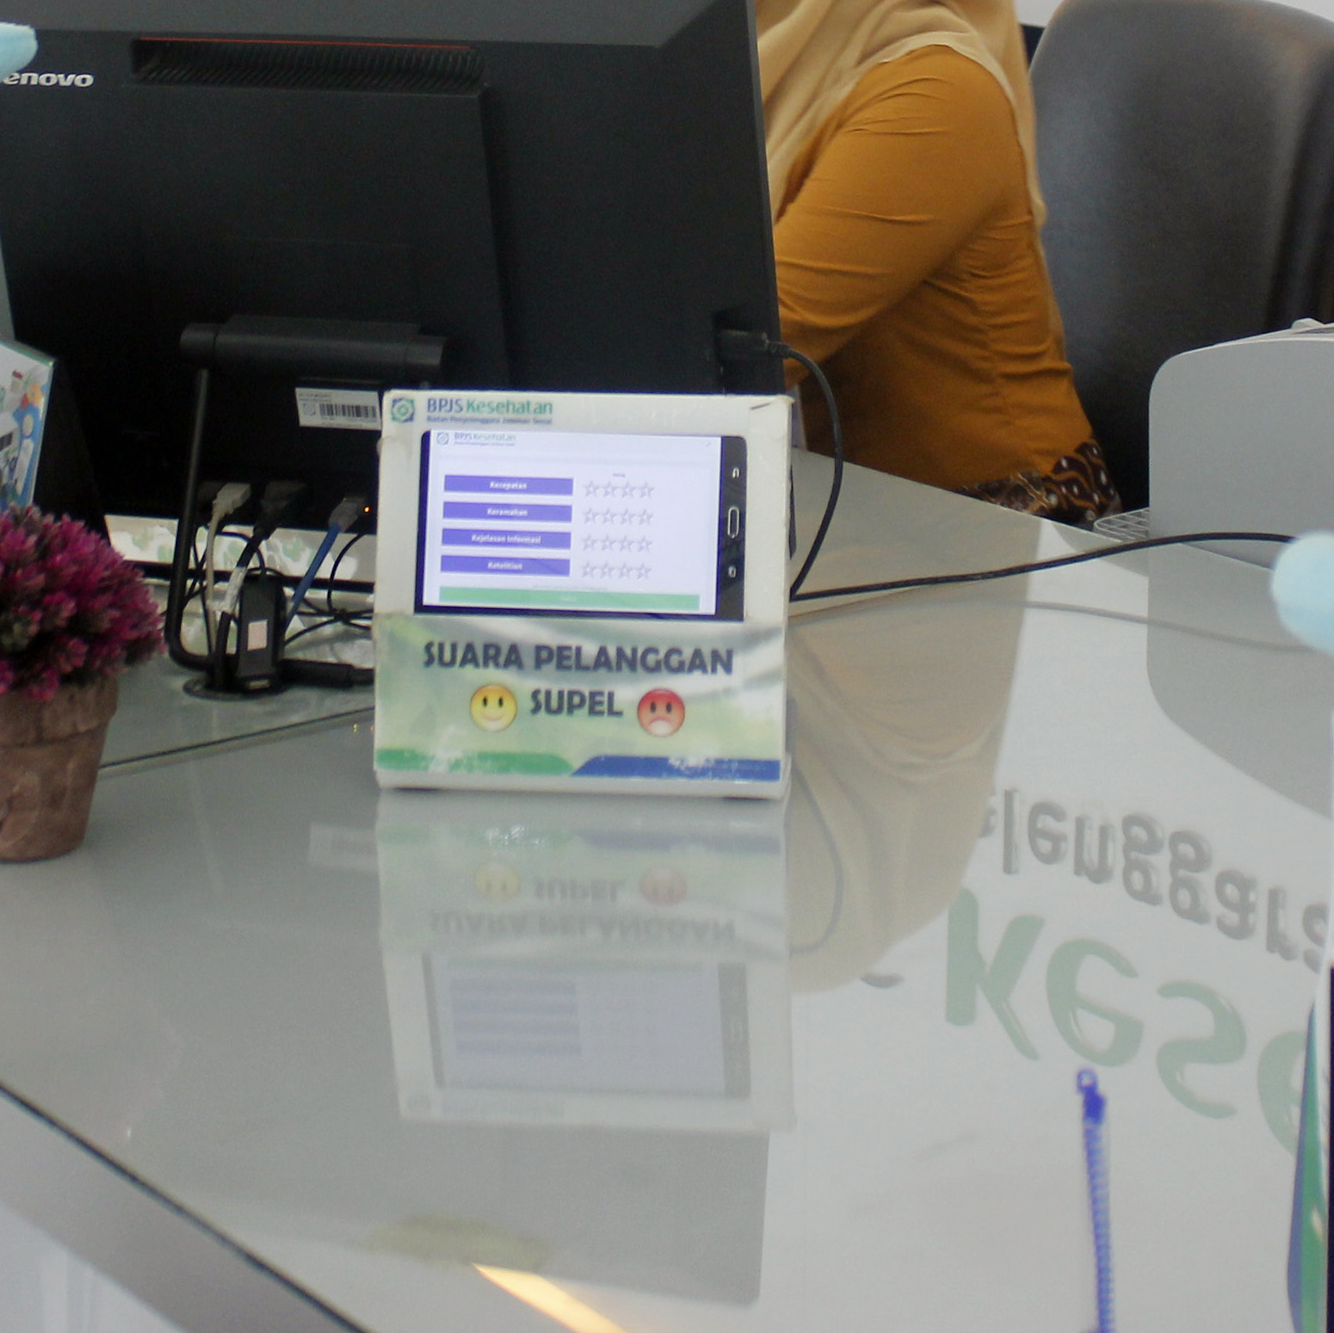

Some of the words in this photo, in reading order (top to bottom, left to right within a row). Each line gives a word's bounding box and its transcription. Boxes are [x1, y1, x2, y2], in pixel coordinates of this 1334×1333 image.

[2, 71, 95, 88] enovo
[426, 397, 464, 414] BPJS
[466, 398, 553, 415] Kesehatan
[423, 640, 525, 671] SUARA
[533, 643, 735, 676] PELANGGAN
[529, 687, 624, 718] SUPEL
